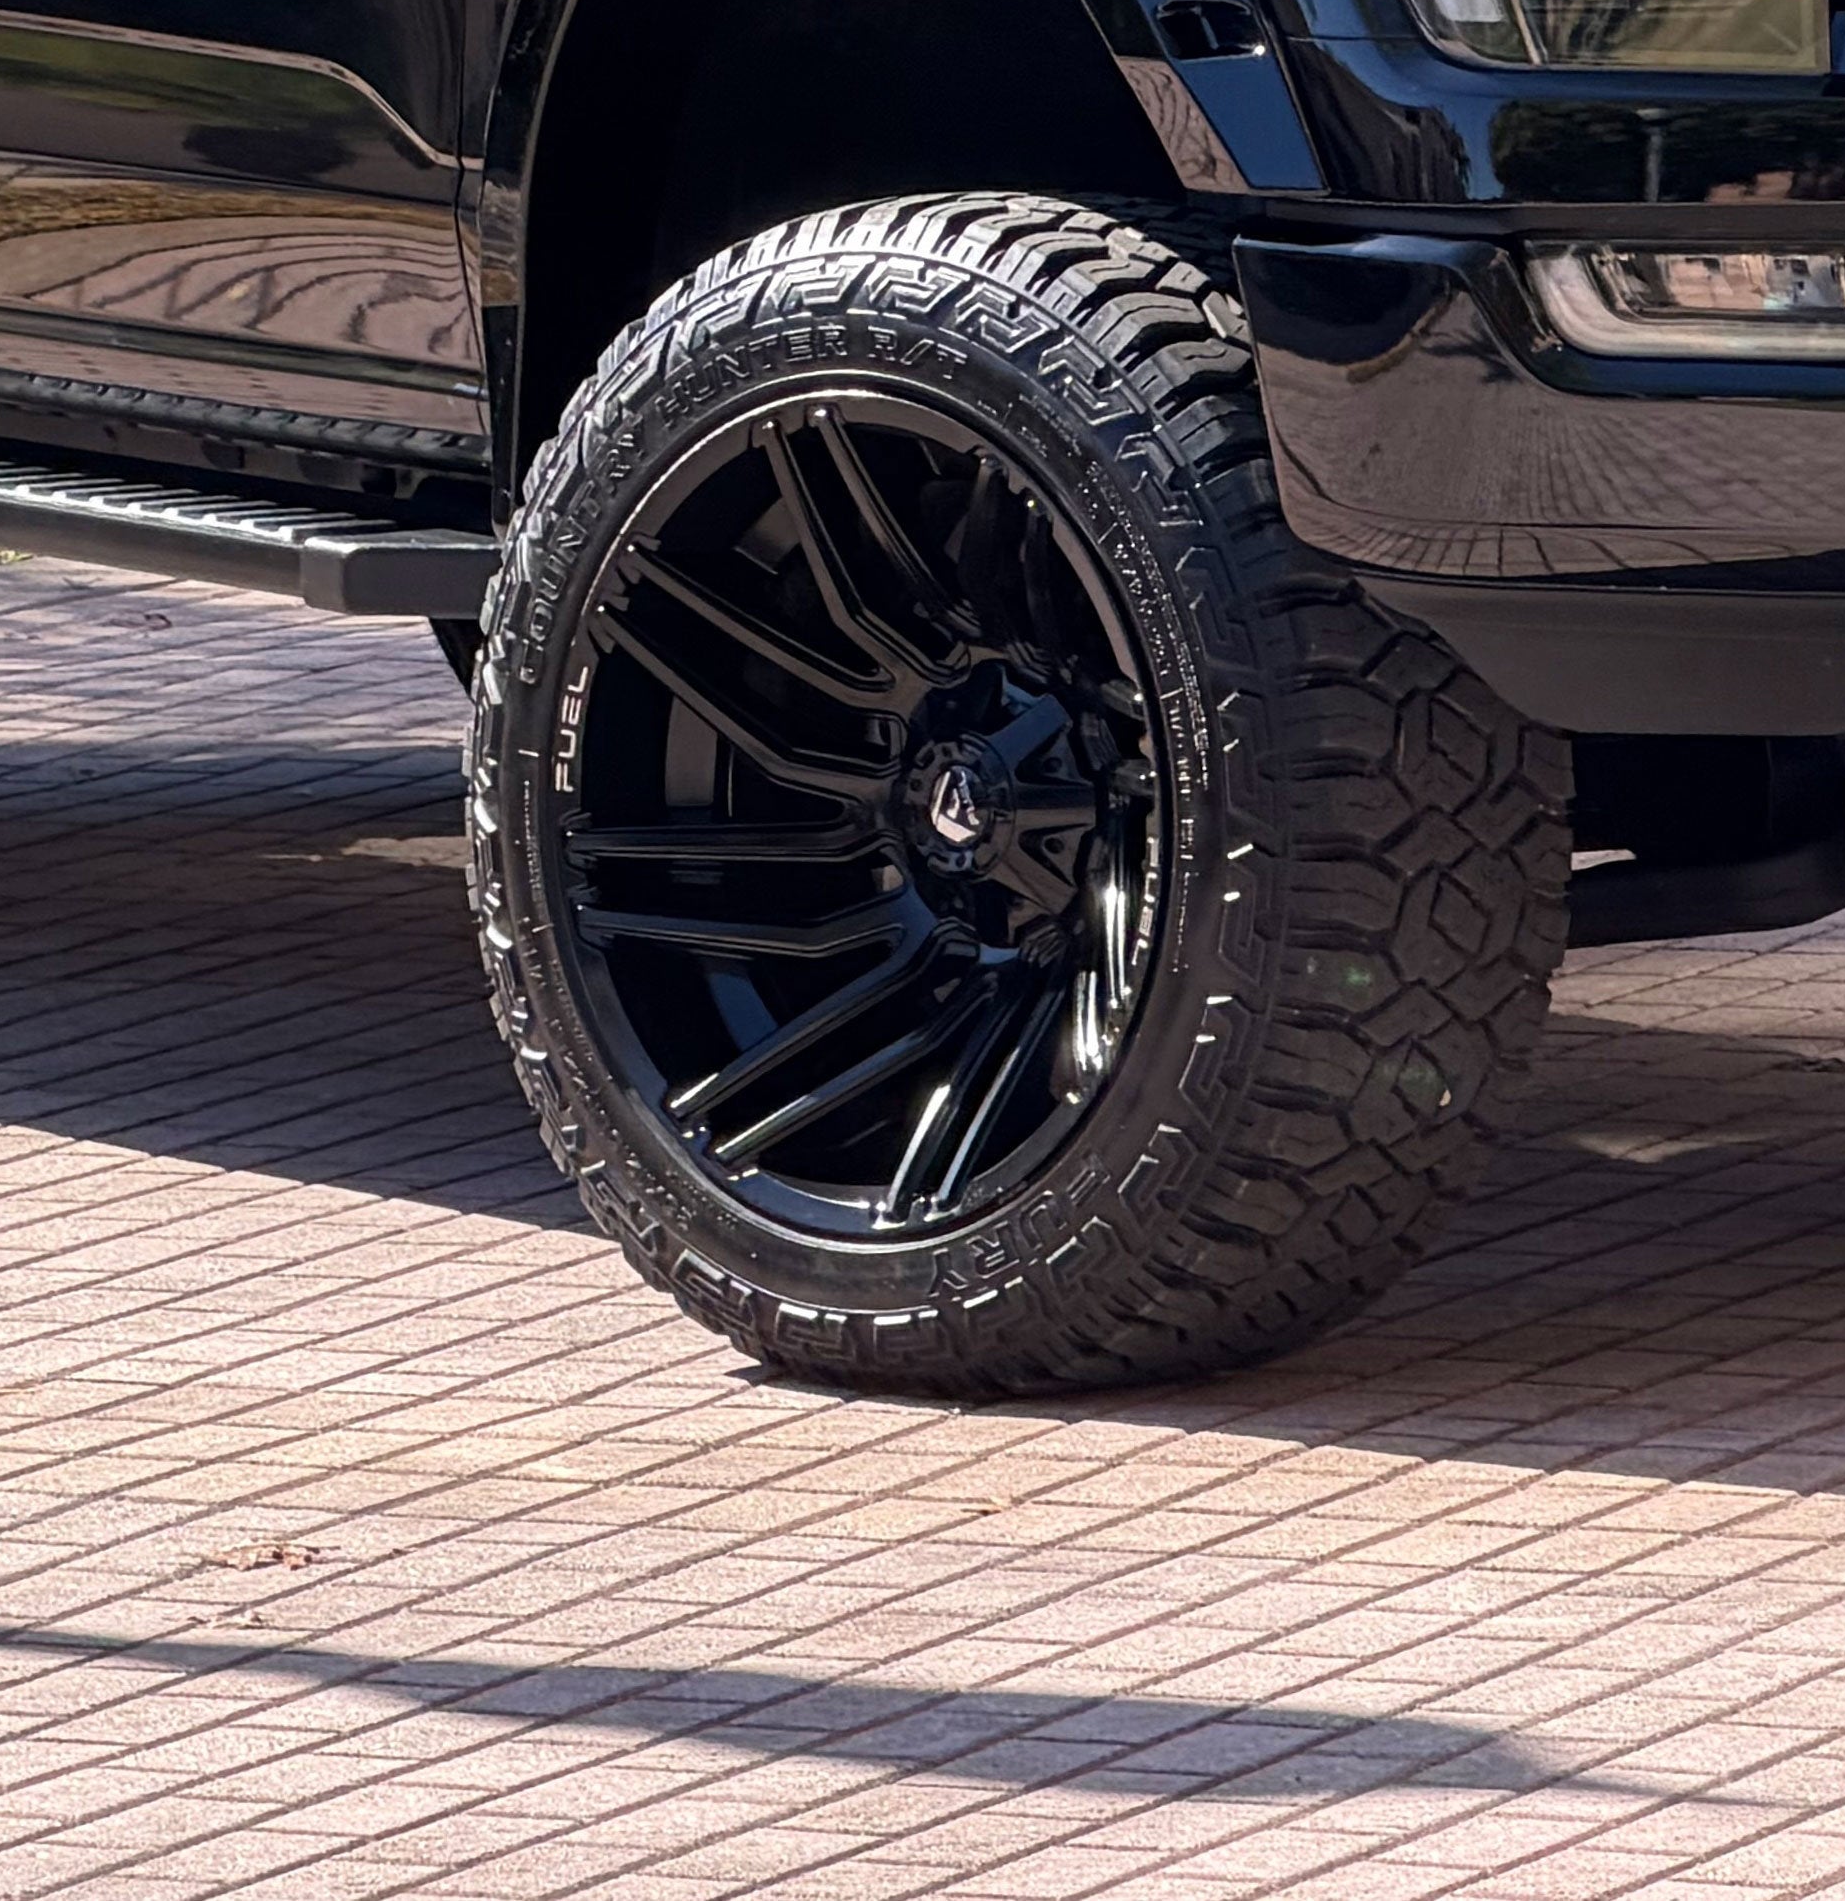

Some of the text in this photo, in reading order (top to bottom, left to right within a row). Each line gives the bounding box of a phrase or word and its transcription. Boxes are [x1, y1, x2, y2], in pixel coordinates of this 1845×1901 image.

[518, 324, 969, 686] COUNTRY HUNTER R/T
[554, 665, 589, 793] FUEL
[1131, 836, 1159, 966] FUEL
[928, 1154, 1111, 1304] FURY
